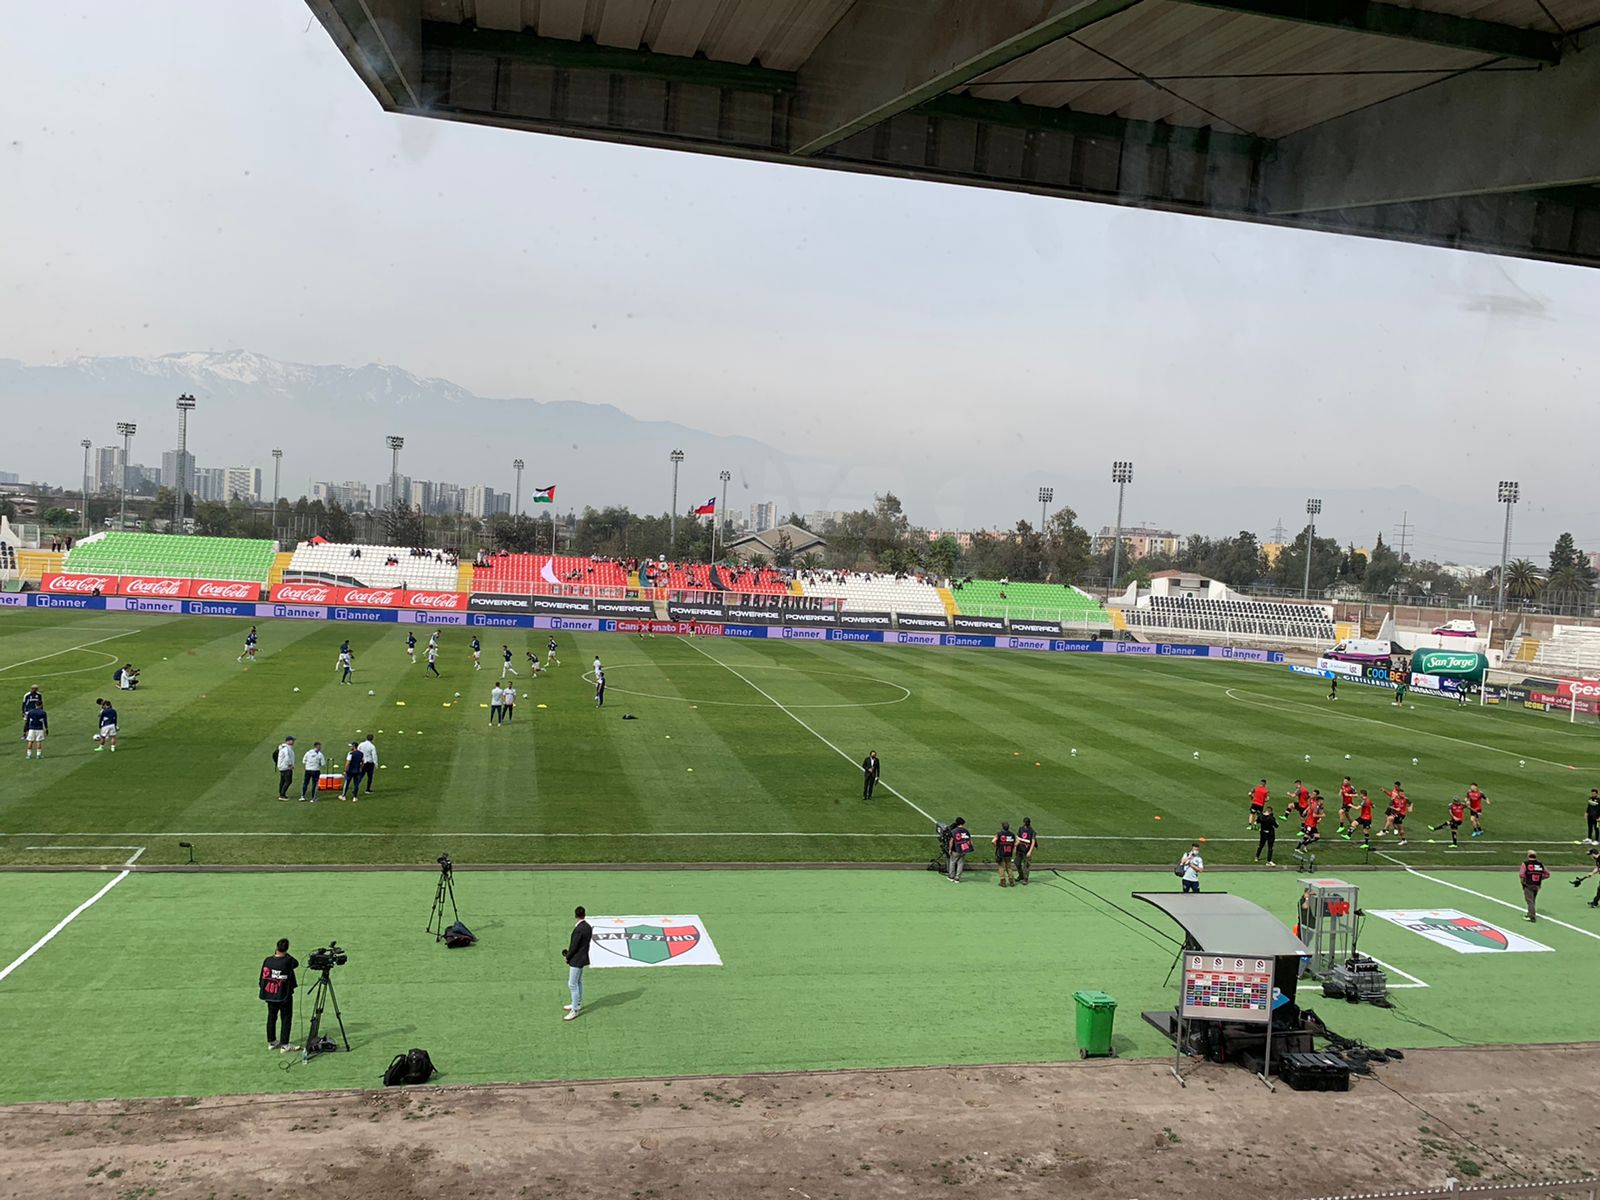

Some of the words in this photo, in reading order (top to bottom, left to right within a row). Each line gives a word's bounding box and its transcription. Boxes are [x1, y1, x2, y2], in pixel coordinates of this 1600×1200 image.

[36, 595, 87, 607] Tanner
[125, 598, 174, 611] Tanner
[471, 598, 528, 608] POWERADE
[534, 601, 590, 611] POWERADE
[189, 601, 238, 614] Tanner
[274, 604, 320, 617] Tanner
[597, 604, 652, 613] POWERADE
[670, 607, 723, 617] POWERADE
[335, 608, 381, 620] Tanner
[415, 611, 459, 623] Tanner
[728, 610, 780, 619] POWERADE
[785, 613, 836, 622] POWERADE
[474, 614, 517, 626] Tanner
[551, 617, 592, 629] Tanner
[841, 616, 890, 625] POWERADE
[899, 618, 947, 627] POWERADE
[955, 619, 1003, 629] POWERADE
[679, 623, 722, 635] PlnVital
[782, 627, 820, 639] Tanner
[1012, 624, 1060, 633] POWERADE
[832, 629, 870, 641] Tanner
[898, 631, 934, 643] Tanner
[946, 635, 982, 646] Tanner
[1009, 637, 1044, 648] Tanner
[1055, 641, 1090, 651] Tanner
[1116, 642, 1150, 653] Tanner
[1162, 644, 1196, 655] Tanner
[1222, 647, 1260, 660] Tanner
[1427, 656, 1447, 667] San
[1448, 656, 1475, 668] Jorge
[597, 932, 695, 942] PALESTINO
